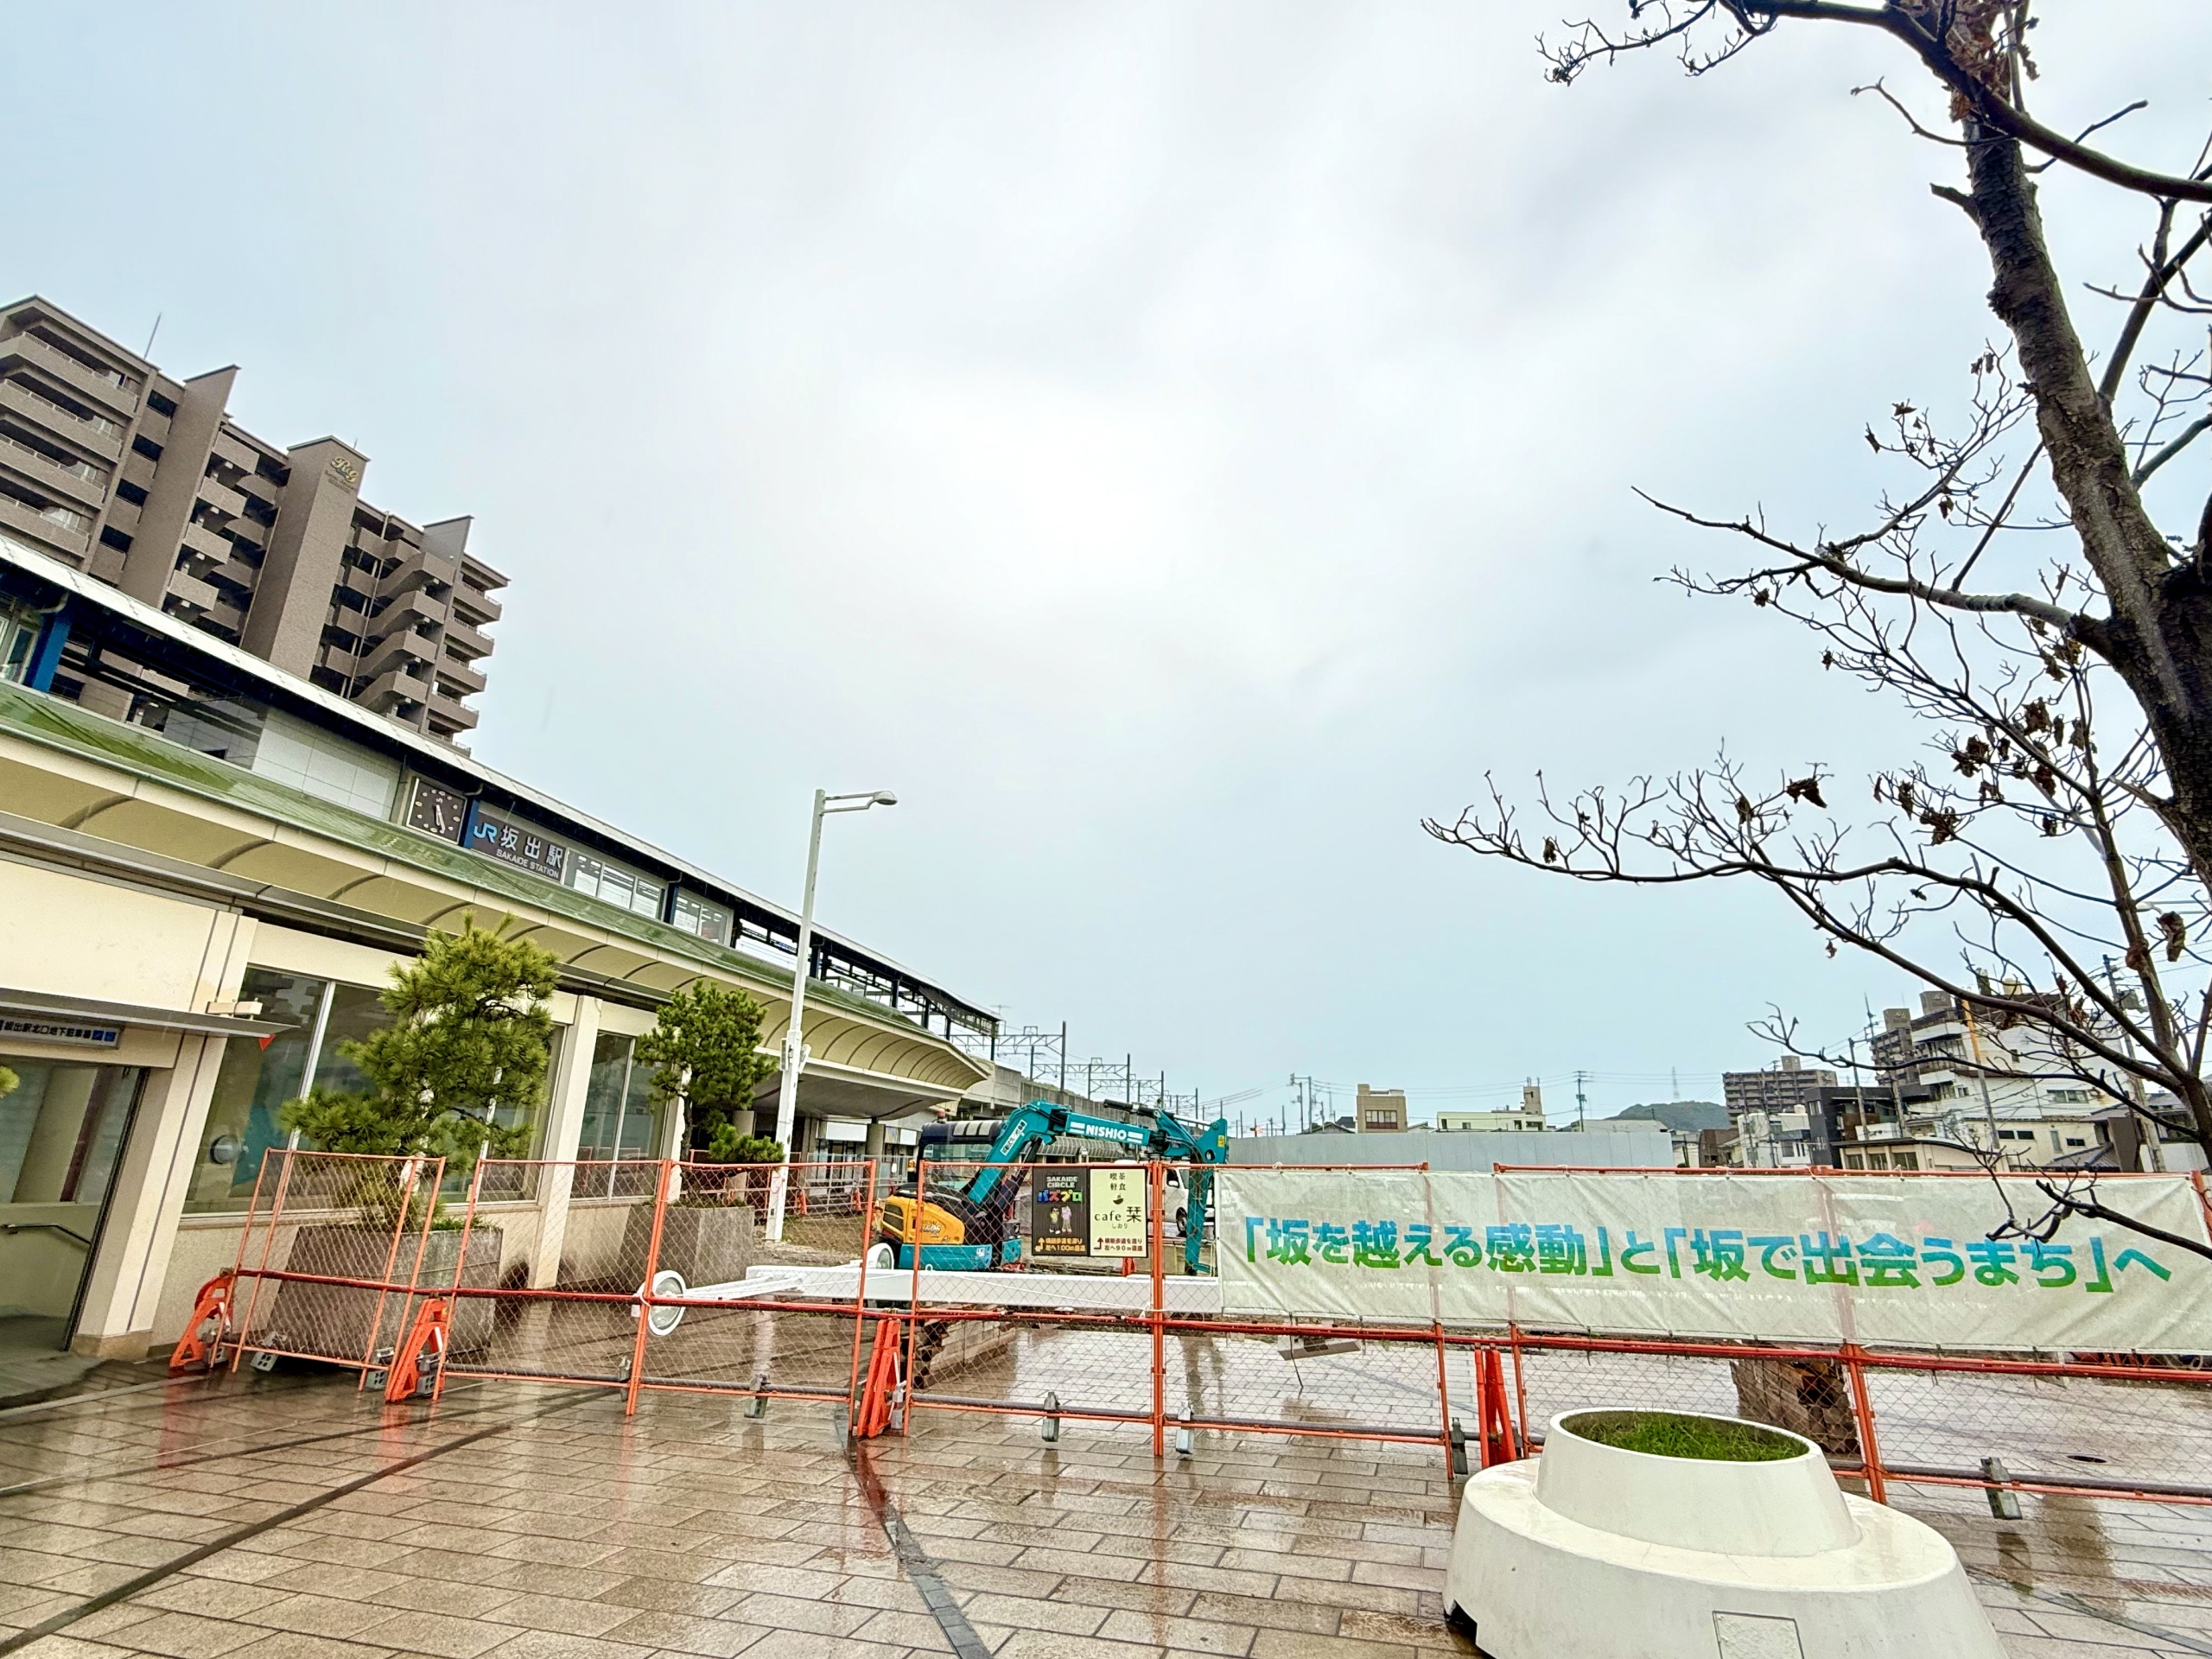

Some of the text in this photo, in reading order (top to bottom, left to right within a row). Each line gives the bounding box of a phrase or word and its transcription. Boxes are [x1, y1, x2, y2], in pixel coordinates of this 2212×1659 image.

[473, 823, 563, 868] JR 坂出駅
[496, 849, 560, 879] SAKAIDE STATION
[1085, 1124, 1128, 1141] NISHIO
[1110, 1182, 1126, 1191] 軽食
[1037, 1189, 1083, 1202] パズプロ
[1094, 1206, 1141, 1223] cafe 栞
[1245, 1217, 2171, 1293] 「坂を越える感動」と「坂で出会うまち」へ
